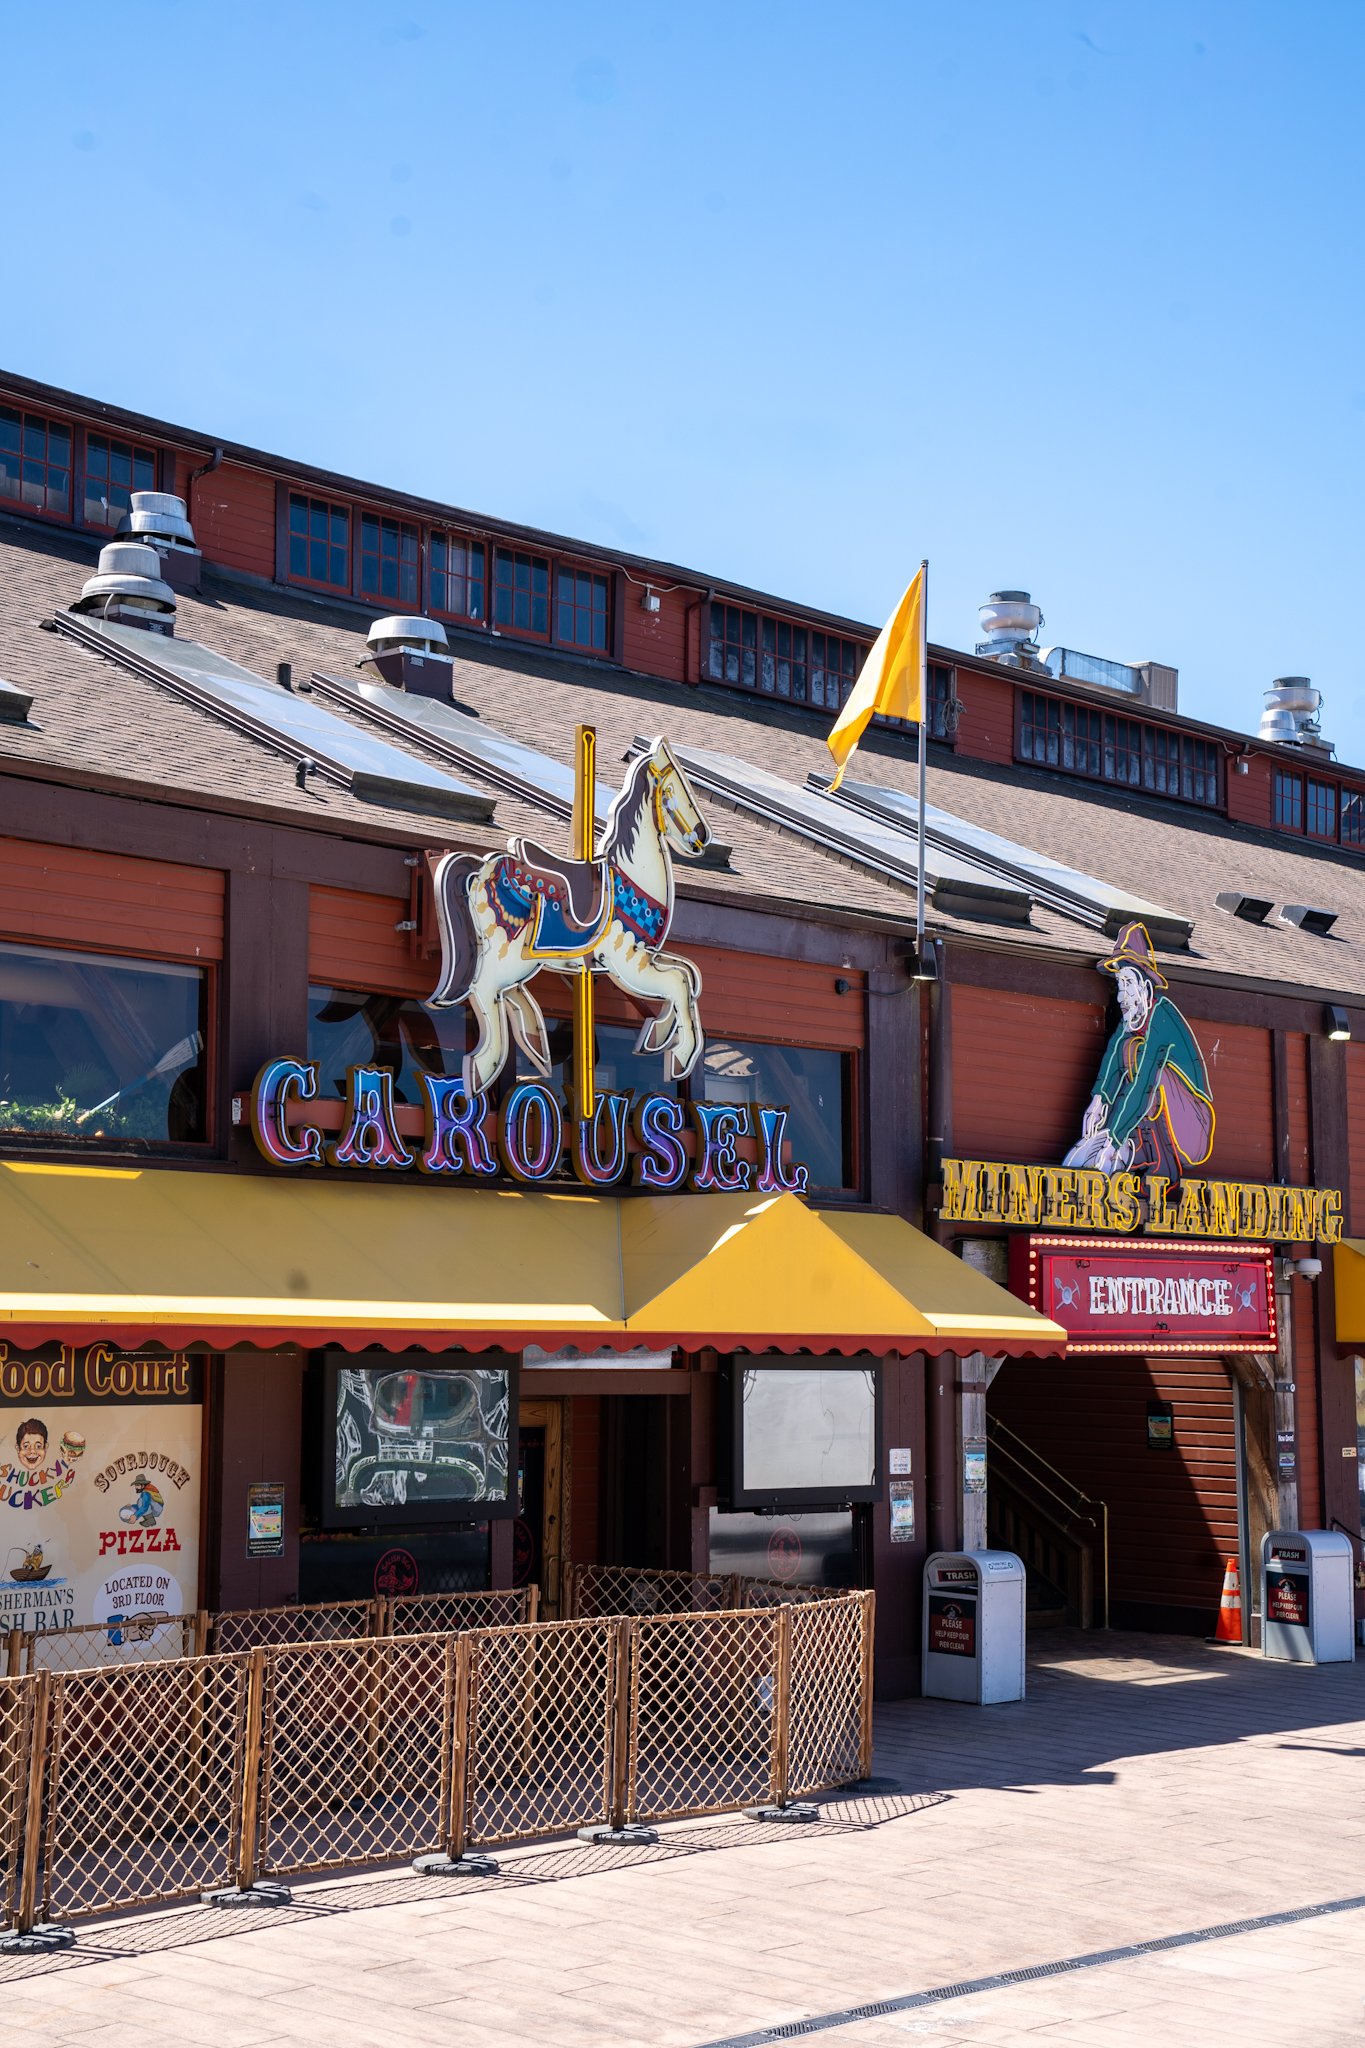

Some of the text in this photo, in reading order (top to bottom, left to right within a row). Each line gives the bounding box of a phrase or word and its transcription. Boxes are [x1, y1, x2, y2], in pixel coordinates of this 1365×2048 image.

[251, 1055, 811, 1197] CAROUSEL
[939, 1158, 1344, 1243] MINERS LANDING
[1088, 1274, 1233, 1316] ENTRANCE
[85, 1344, 190, 1396] Court
[94, 1451, 191, 1493] SOURDOUGH
[98, 1527, 182, 1556] PIZZA
[1278, 1550, 1300, 1559] TRASH
[945, 1571, 976, 1580] TRASH
[105, 1576, 170, 1594] LOCATED ON
[113, 1592, 165, 1609] 3RD FLOOR
[1278, 1591, 1297, 1601] PLEASE
[34, 1608, 74, 1632] BAR
[941, 1618, 963, 1629] PLEASE
[935, 1629, 970, 1640] HELP KEEP OUR
[939, 1640, 965, 1650] PIER CLEAN
